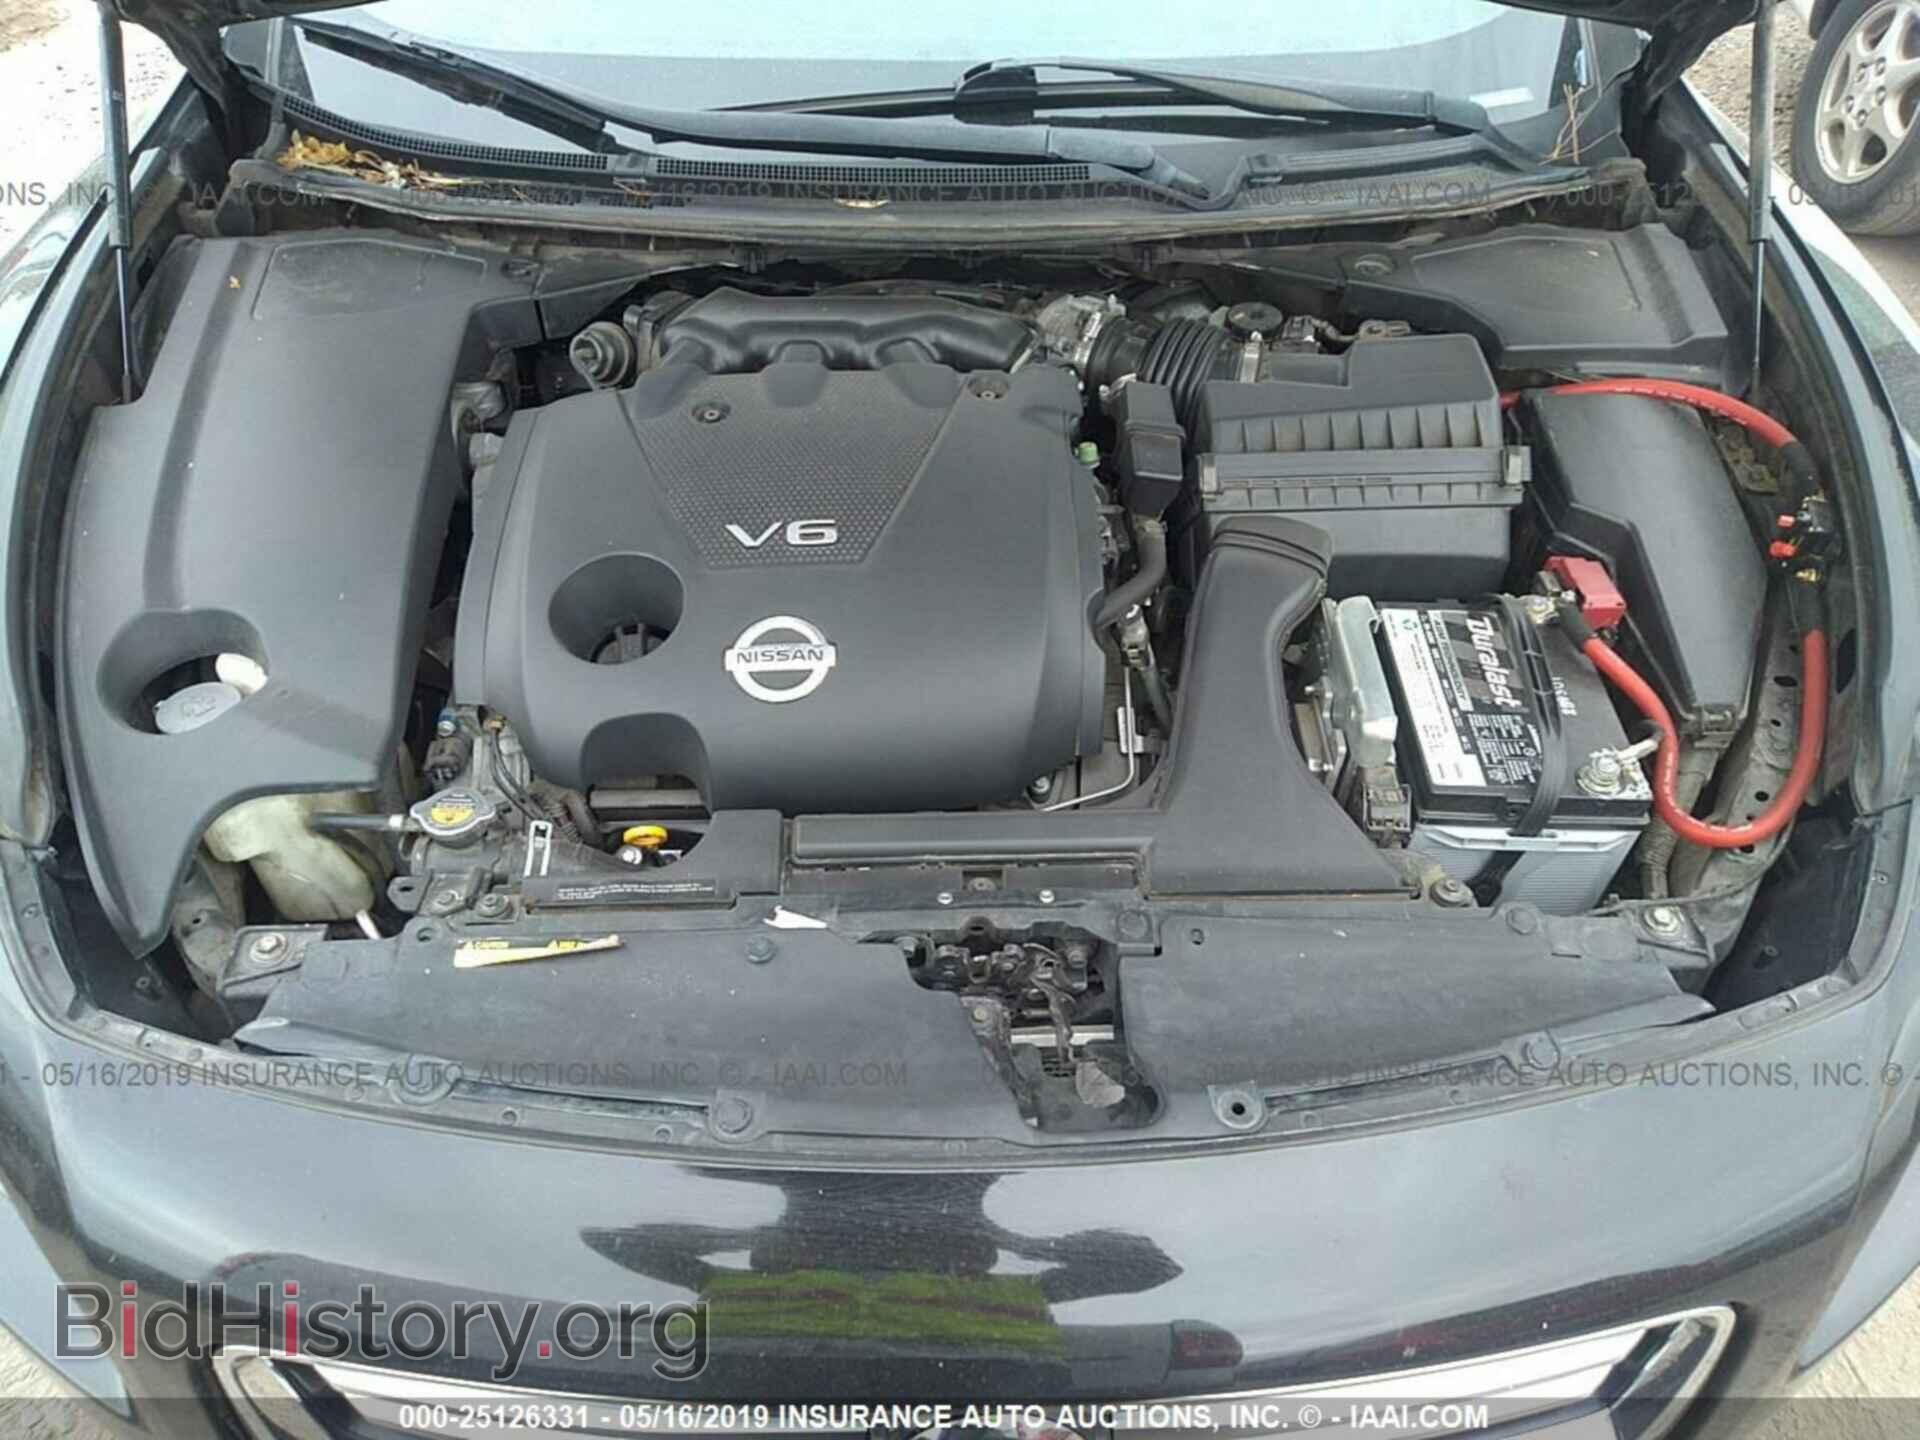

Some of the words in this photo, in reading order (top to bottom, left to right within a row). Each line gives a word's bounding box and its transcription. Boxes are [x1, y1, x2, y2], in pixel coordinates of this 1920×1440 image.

[725, 519, 838, 547] V6
[737, 649, 823, 664] NISSAN
[1467, 616, 1523, 708] Duralast
